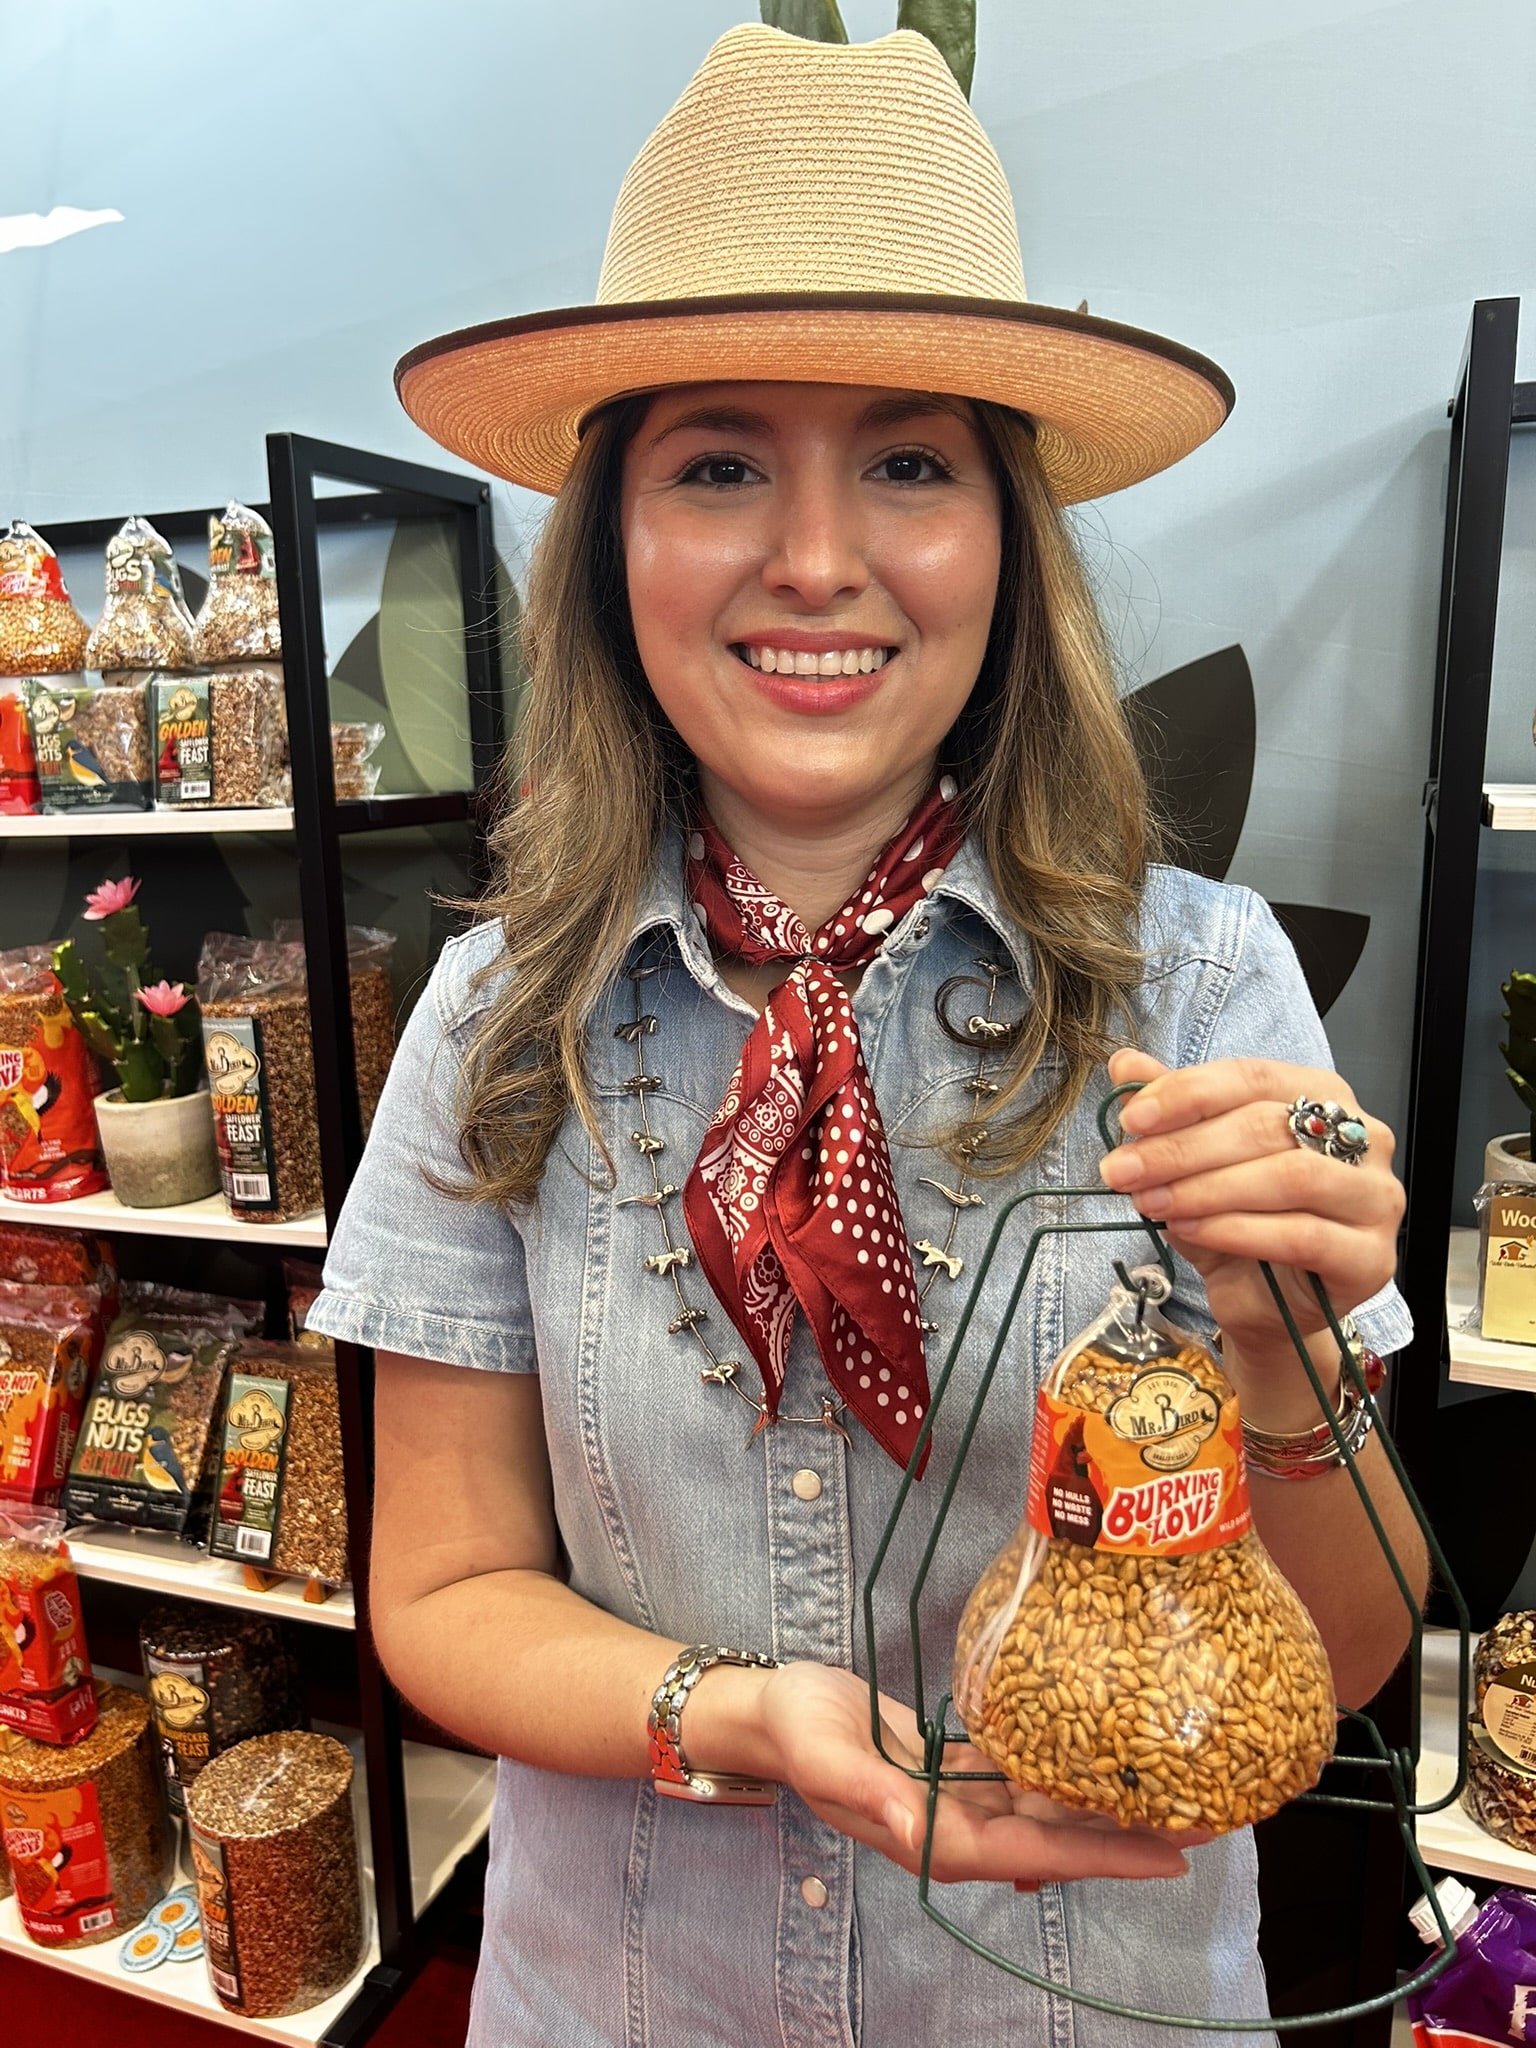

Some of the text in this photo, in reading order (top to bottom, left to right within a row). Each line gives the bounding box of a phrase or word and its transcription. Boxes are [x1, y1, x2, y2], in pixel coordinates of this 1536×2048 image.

[159, 719, 208, 741] GOLDEN
[36, 733, 61, 747] UGS
[180, 746, 209, 765] FEAST
[0, 1052, 21, 1065] ING
[0, 1065, 20, 1088] VE
[226, 1124, 261, 1142] FEAST
[12, 1374, 37, 1392] HOT
[92, 1396, 152, 1428] BUGS
[85, 1421, 145, 1453] NUTS
[223, 1446, 279, 1472] GOLDEN
[243, 1478, 277, 1501] FEAST
[1053, 1486, 1090, 1504] NO HULLS
[1052, 1497, 1092, 1516] NO WASTE
[1106, 1471, 1220, 1538] BURNING
[1054, 1509, 1090, 1527] NO MESS
[1146, 1489, 1219, 1545] LOVE
[176, 1742, 209, 1758] FEAST
